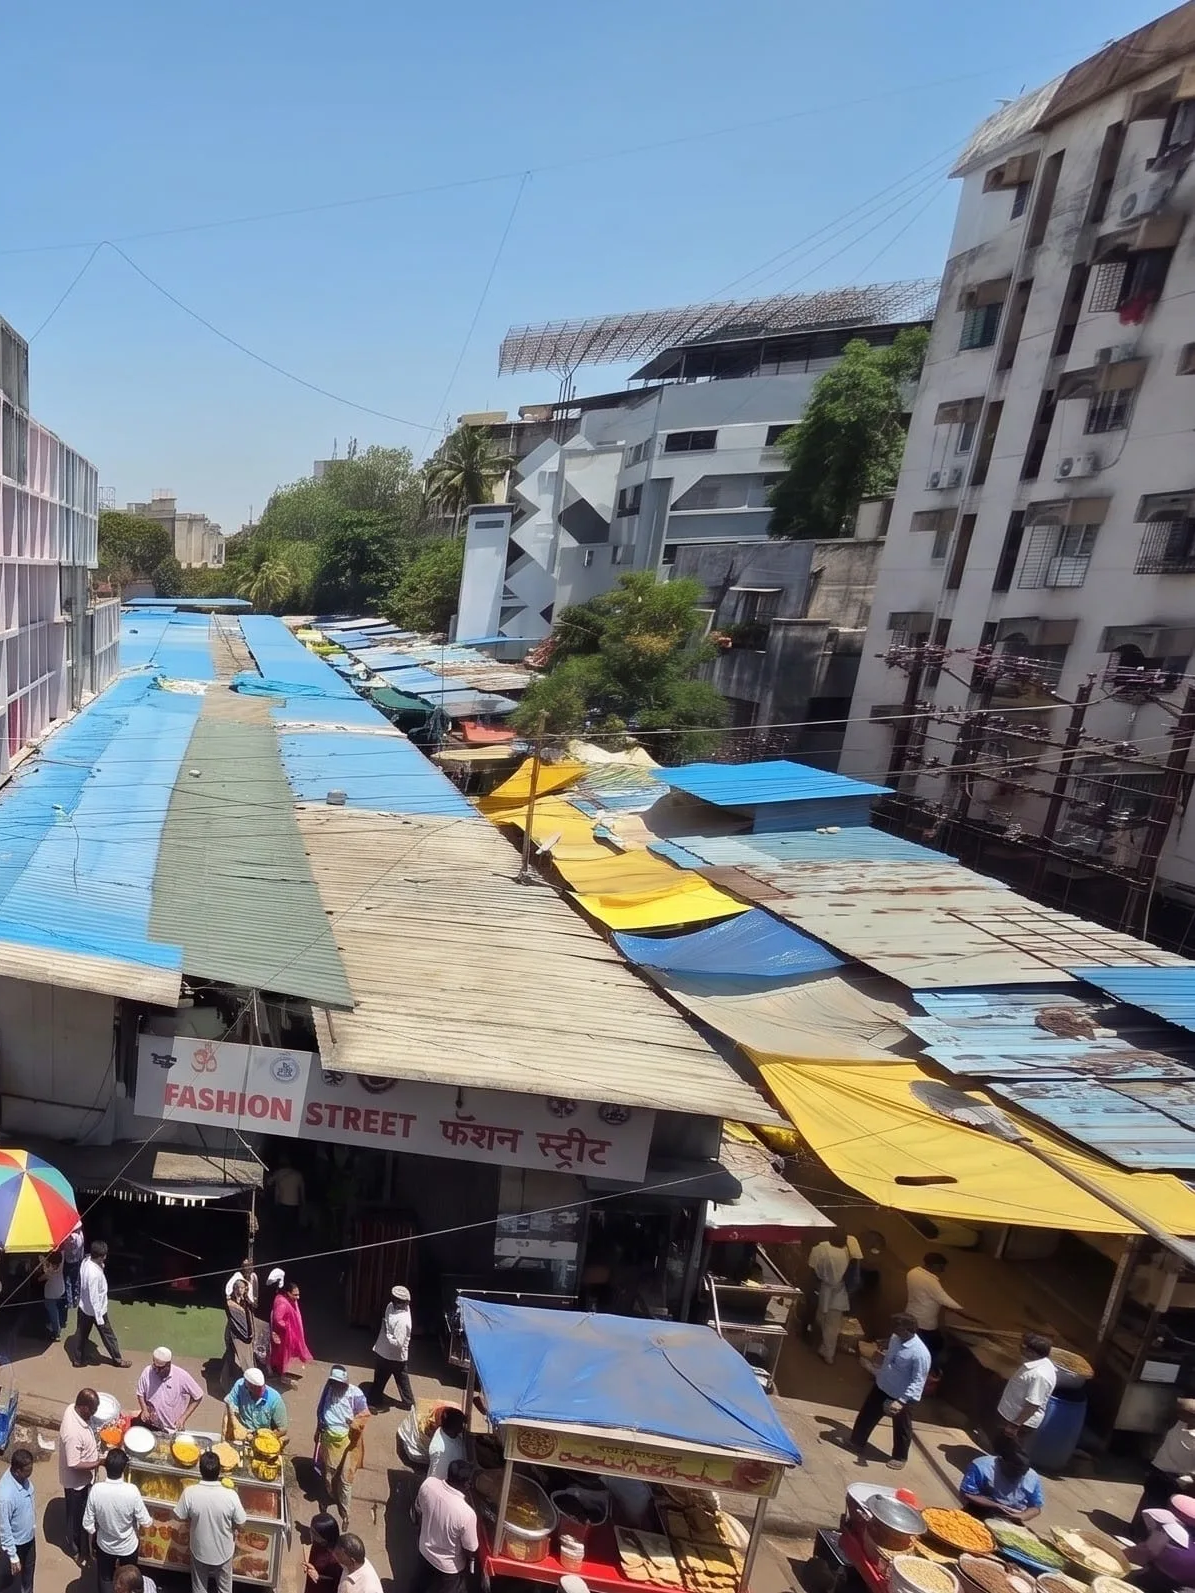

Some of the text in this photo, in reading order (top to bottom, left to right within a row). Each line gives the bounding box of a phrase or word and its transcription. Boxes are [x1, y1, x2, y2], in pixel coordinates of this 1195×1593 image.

[164, 1083, 417, 1138] FASHION STREET
[536, 1128, 612, 1169] स्ट्रीट
